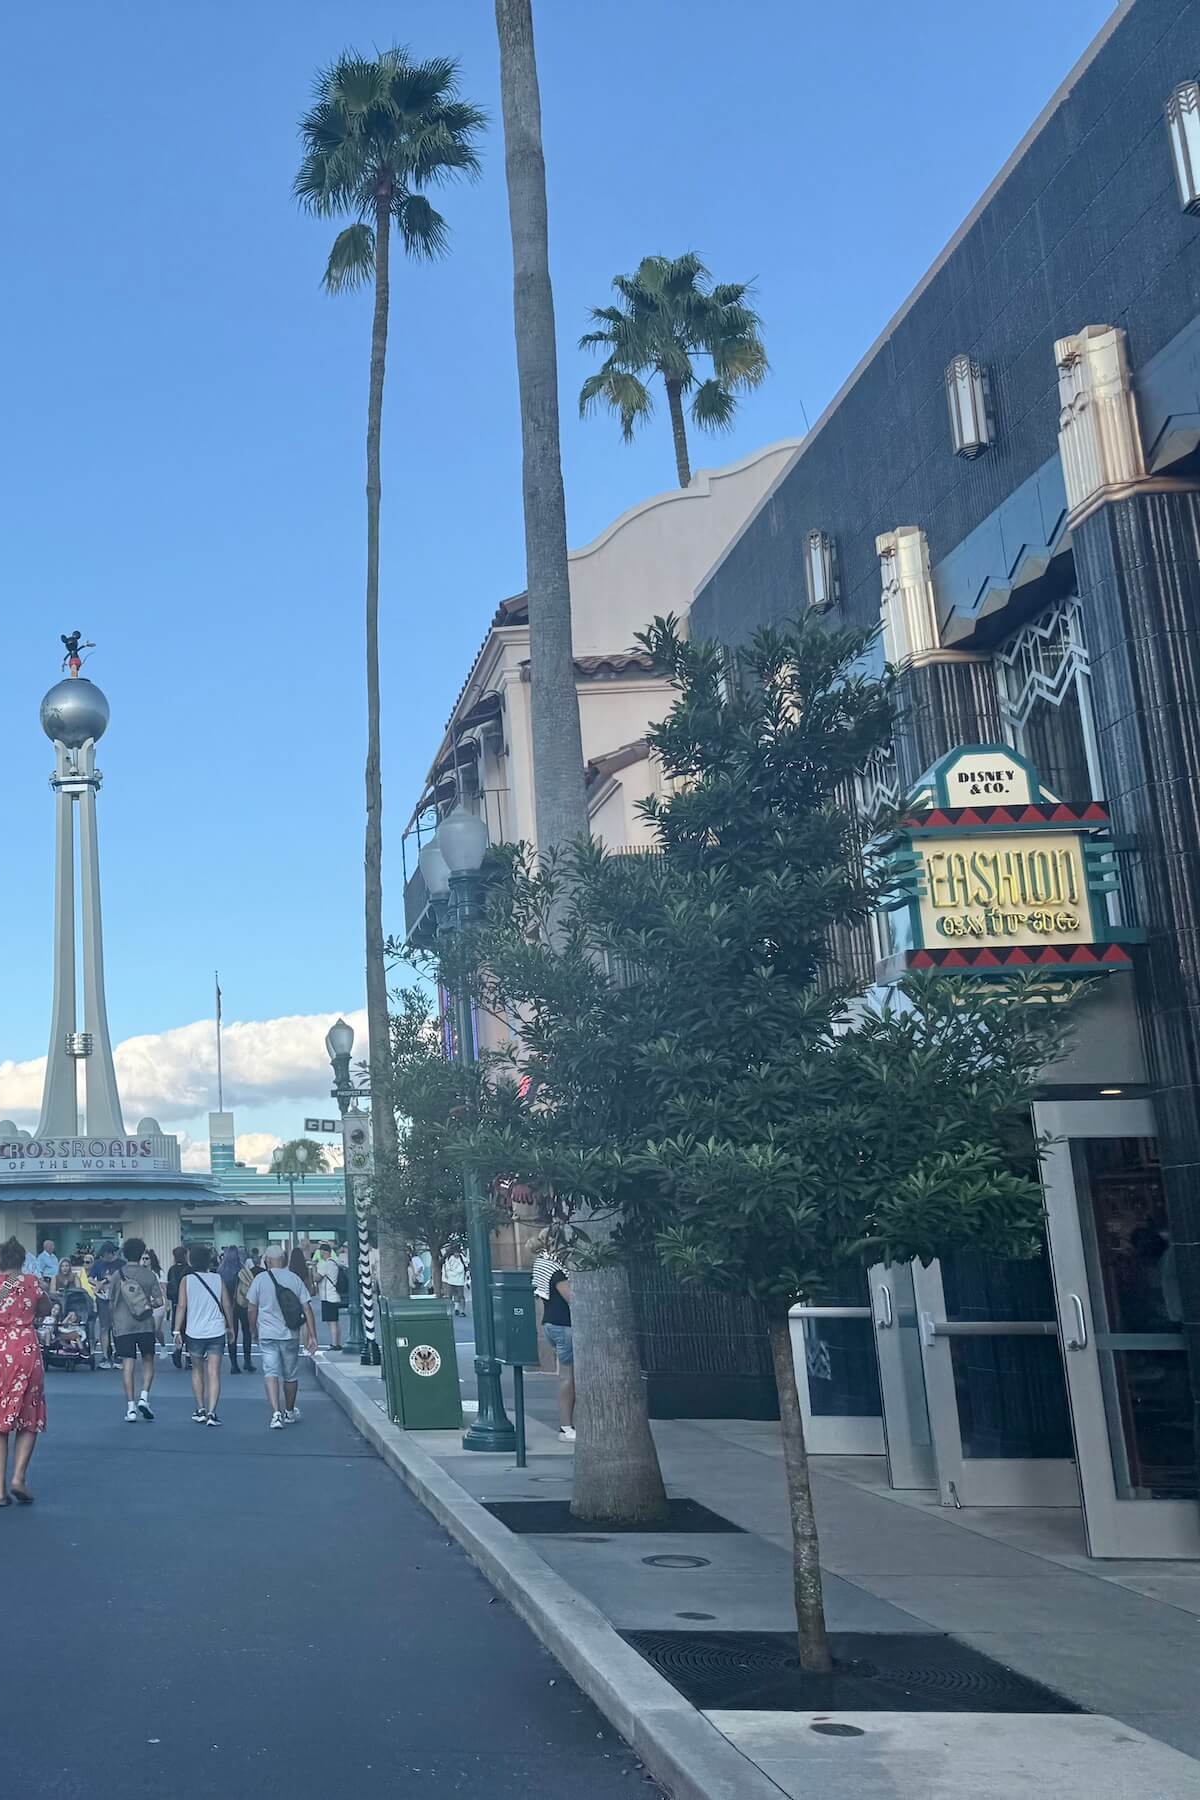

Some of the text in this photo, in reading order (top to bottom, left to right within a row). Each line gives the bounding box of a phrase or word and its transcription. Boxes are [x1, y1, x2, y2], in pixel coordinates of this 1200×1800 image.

[958, 770, 1015, 783] DISNEY
[970, 783, 1010, 795] & CO.
[927, 848, 1079, 908] FASHION
[8, 1159, 139, 1170] OF THE WORLD
